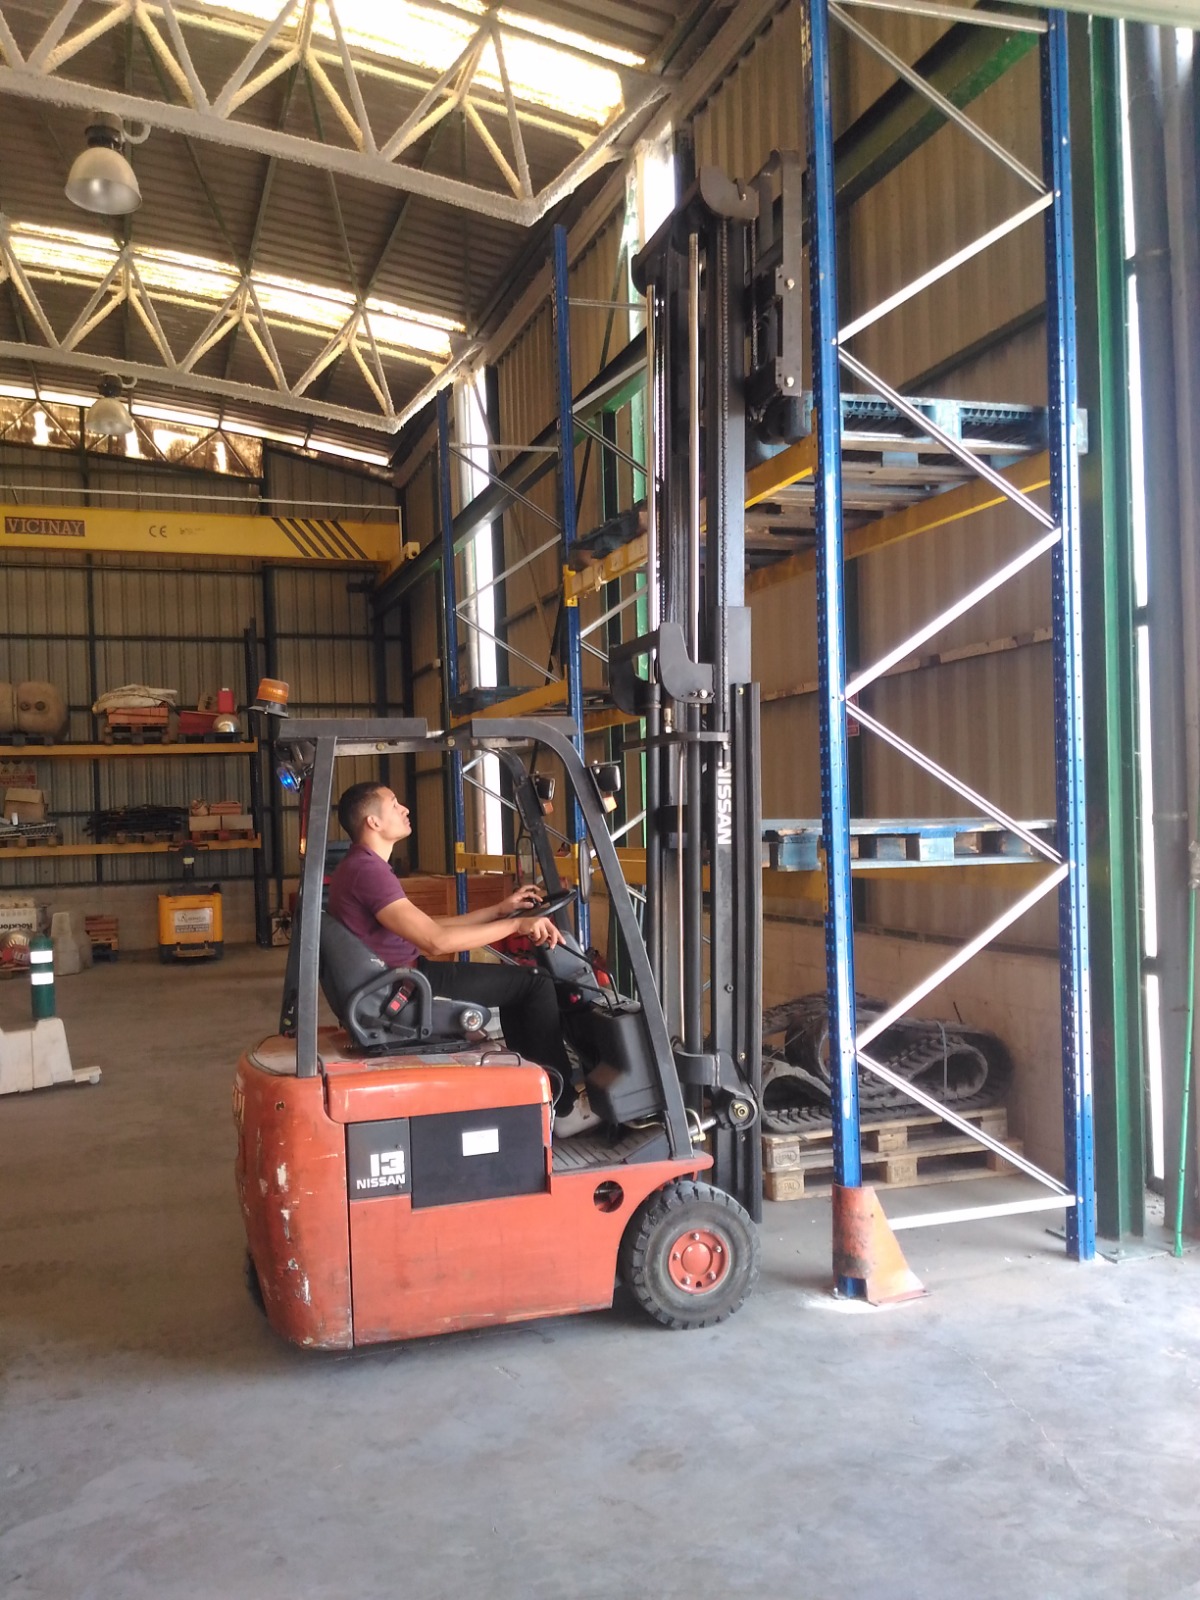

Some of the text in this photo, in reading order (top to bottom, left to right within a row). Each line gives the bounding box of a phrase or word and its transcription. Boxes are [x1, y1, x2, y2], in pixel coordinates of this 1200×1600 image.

[6, 518, 84, 536] VICINAY
[717, 761, 733, 845] NISSAN
[356, 1174, 406, 1190] NISSAN
